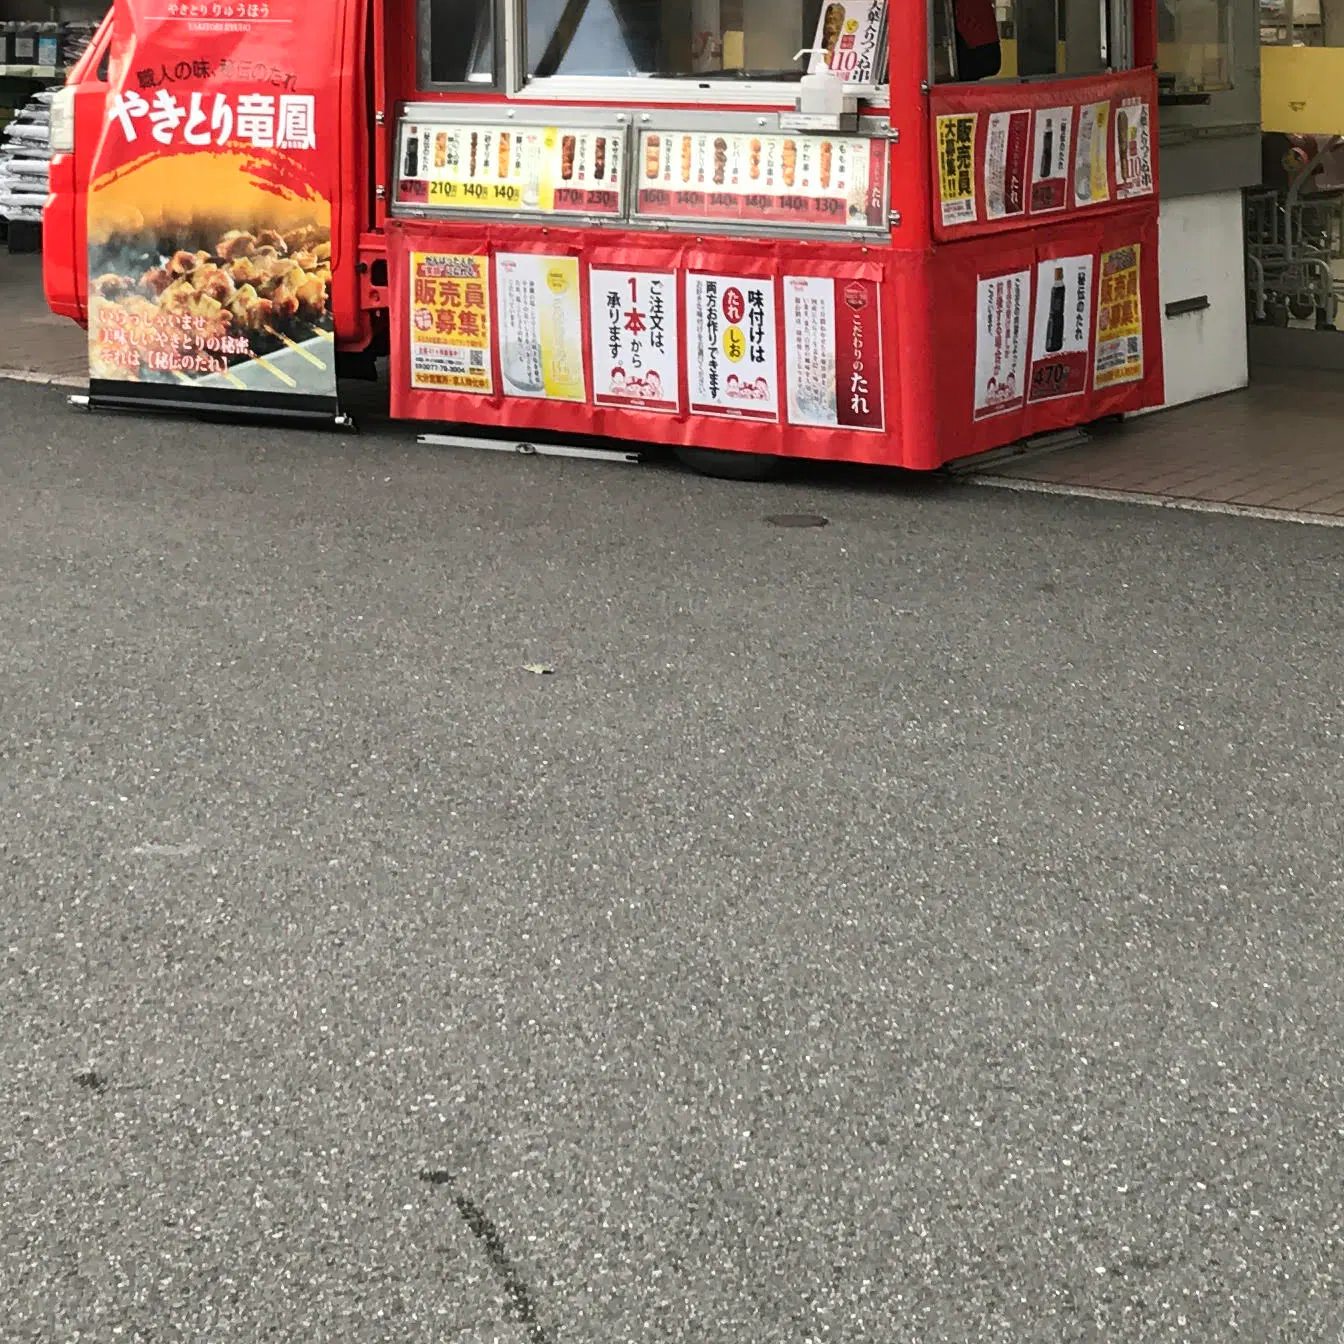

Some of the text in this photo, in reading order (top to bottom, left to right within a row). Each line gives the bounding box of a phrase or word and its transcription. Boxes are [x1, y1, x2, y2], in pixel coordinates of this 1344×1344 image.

[167, 3, 270, 19] やきとり りゅうほう
[108, 88, 316, 150] やきとり竜鳳
[956, 119, 974, 197] 販売員
[98, 310, 207, 332] いらっしゃいませ
[414, 278, 487, 310] 販売員
[623, 277, 647, 368] 1本から
[649, 280, 665, 355] ご注文は、
[727, 289, 740, 320] たれ
[728, 329, 741, 358] しお
[747, 288, 766, 364] 味付けは
[850, 314, 870, 414] こだわりのたれ
